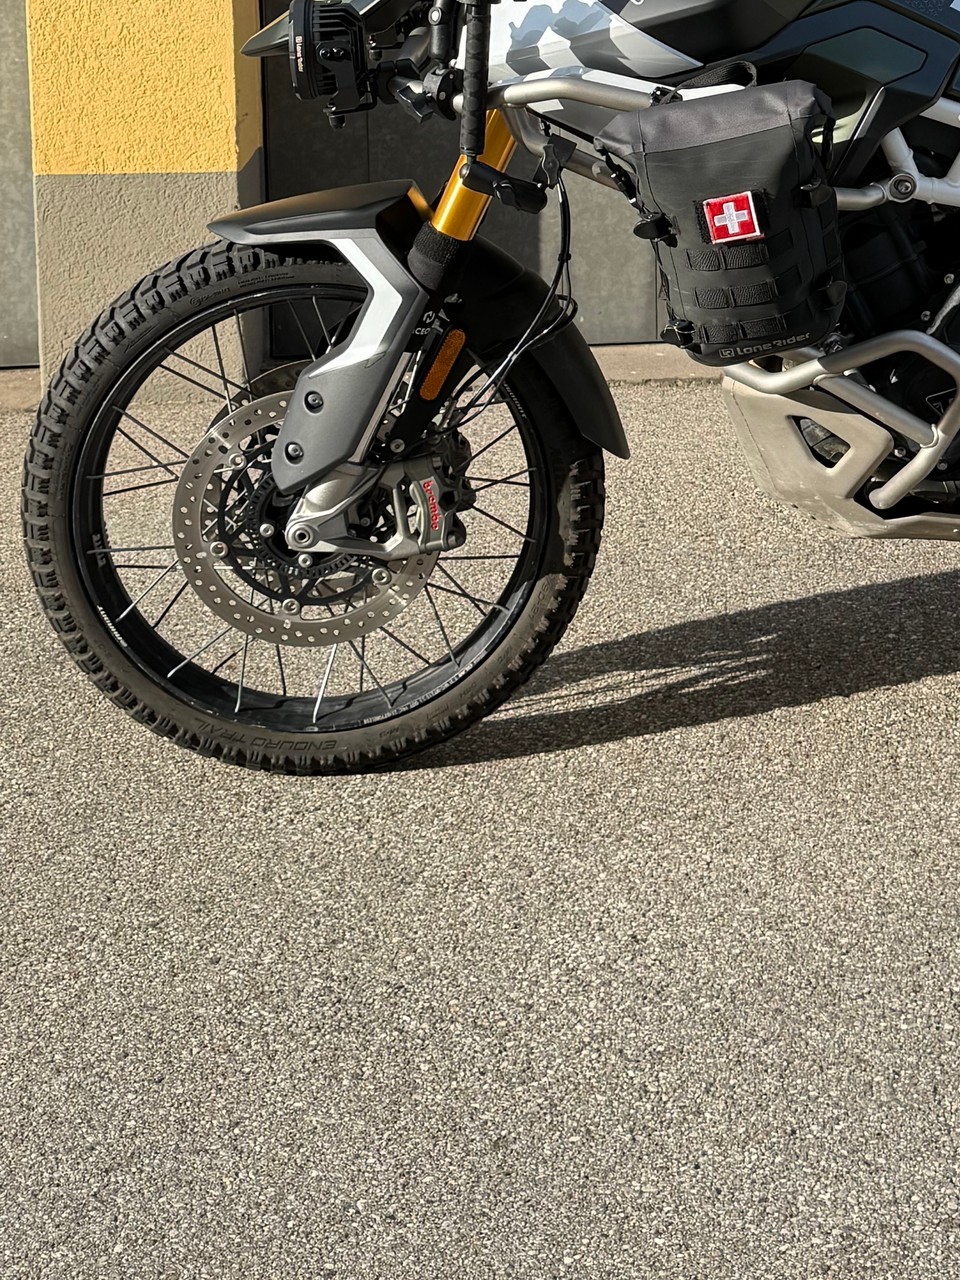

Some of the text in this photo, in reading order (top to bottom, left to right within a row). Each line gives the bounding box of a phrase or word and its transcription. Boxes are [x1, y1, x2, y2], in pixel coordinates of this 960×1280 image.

[423, 480, 441, 531] brembo
[194, 717, 338, 751] ENDURO TRAIL
